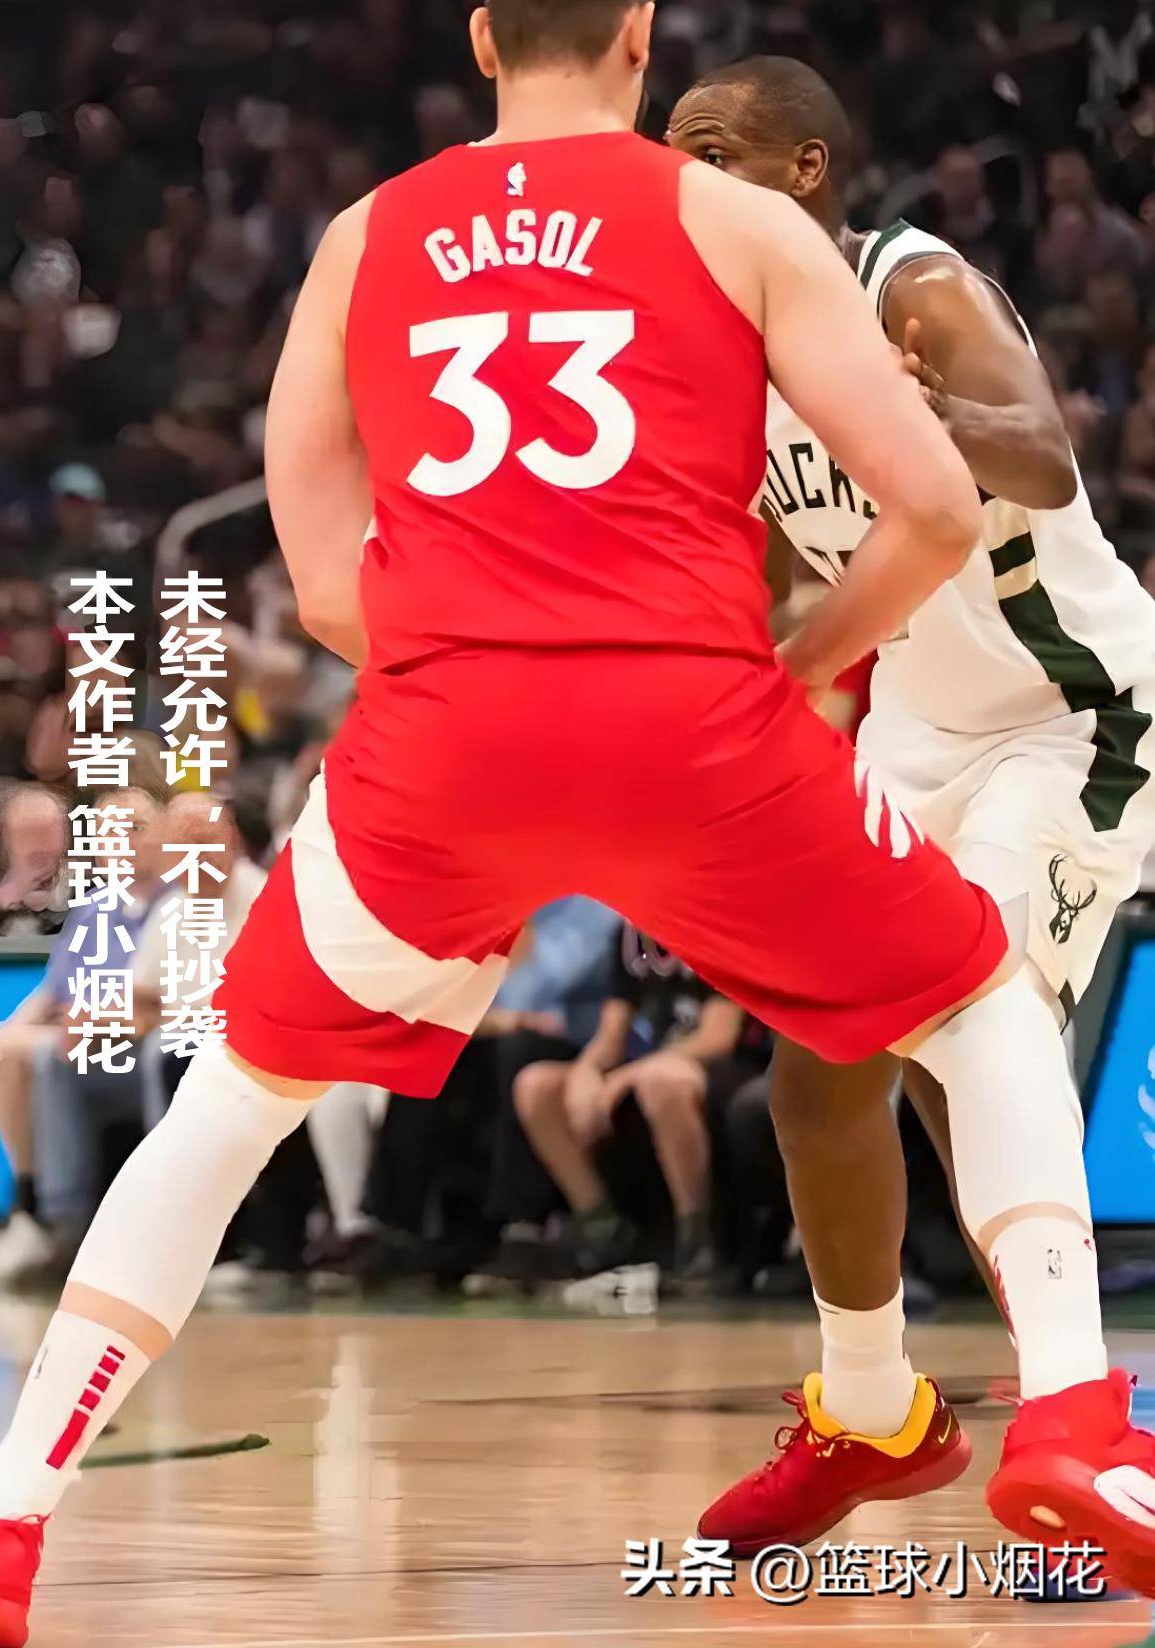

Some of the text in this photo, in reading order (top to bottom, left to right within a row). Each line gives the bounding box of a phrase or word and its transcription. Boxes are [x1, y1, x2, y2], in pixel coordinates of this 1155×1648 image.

[424, 208, 603, 283] GASOL
[406, 309, 636, 497] 33
[761, 442, 878, 523] UCK
